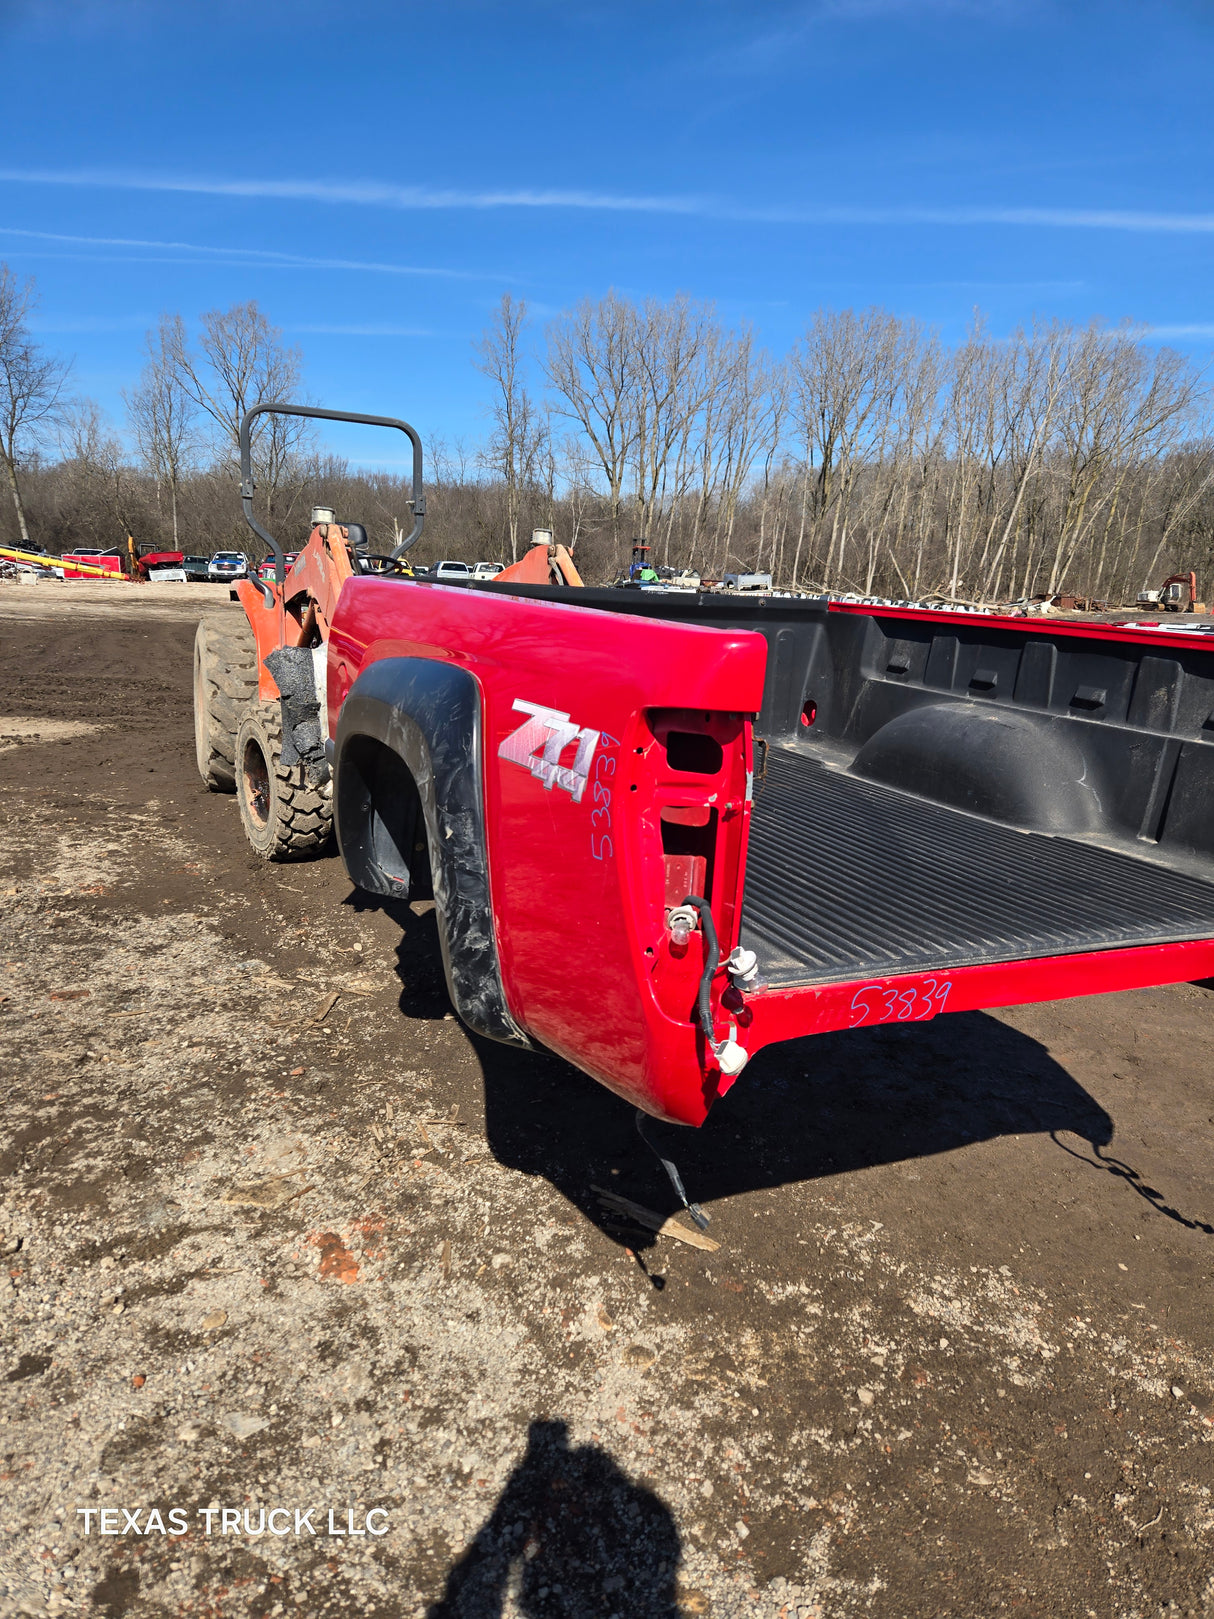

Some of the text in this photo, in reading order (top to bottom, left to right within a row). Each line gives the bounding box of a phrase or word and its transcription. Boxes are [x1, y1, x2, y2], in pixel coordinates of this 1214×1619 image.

[498, 698, 600, 778] Z71
[591, 731, 621, 860] 53839
[849, 979, 952, 1028] 53839
